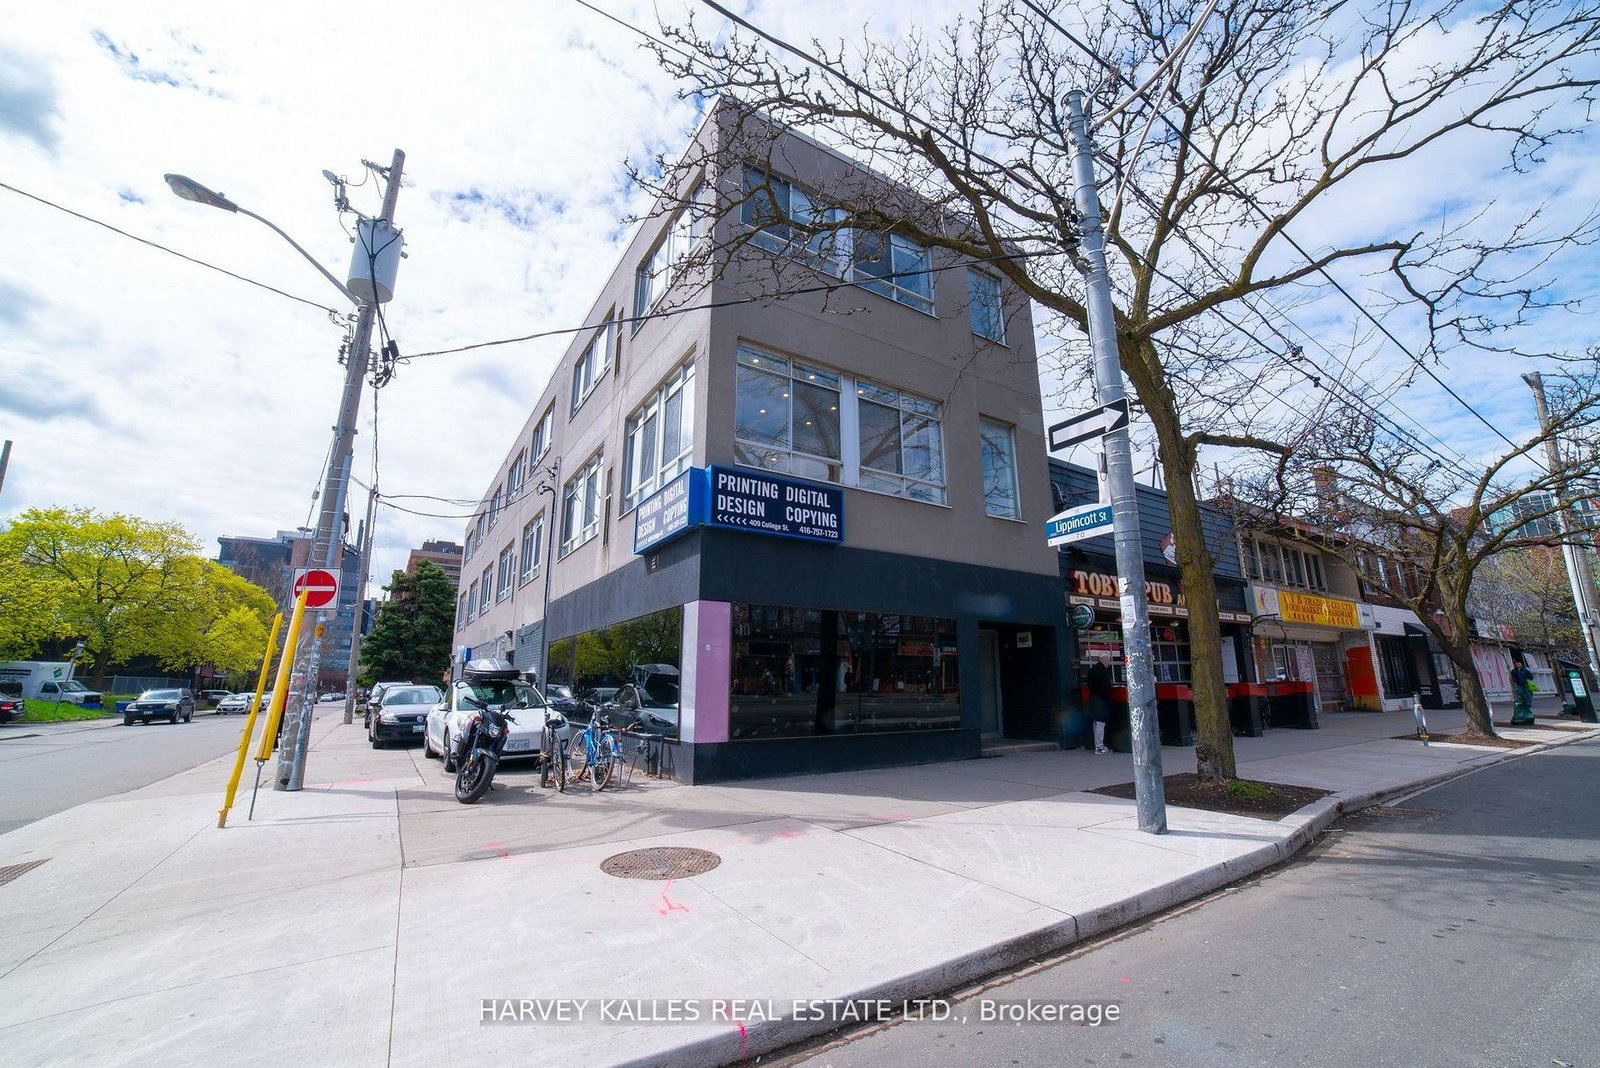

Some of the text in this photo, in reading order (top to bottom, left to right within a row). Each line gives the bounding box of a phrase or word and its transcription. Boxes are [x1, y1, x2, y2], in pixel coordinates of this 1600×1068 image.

[718, 473, 831, 508] PRINTING DIGITAL
[717, 494, 838, 528] DESIGN COPYING
[1055, 511, 1107, 534] Lippincott St
[761, 521, 782, 531] College
